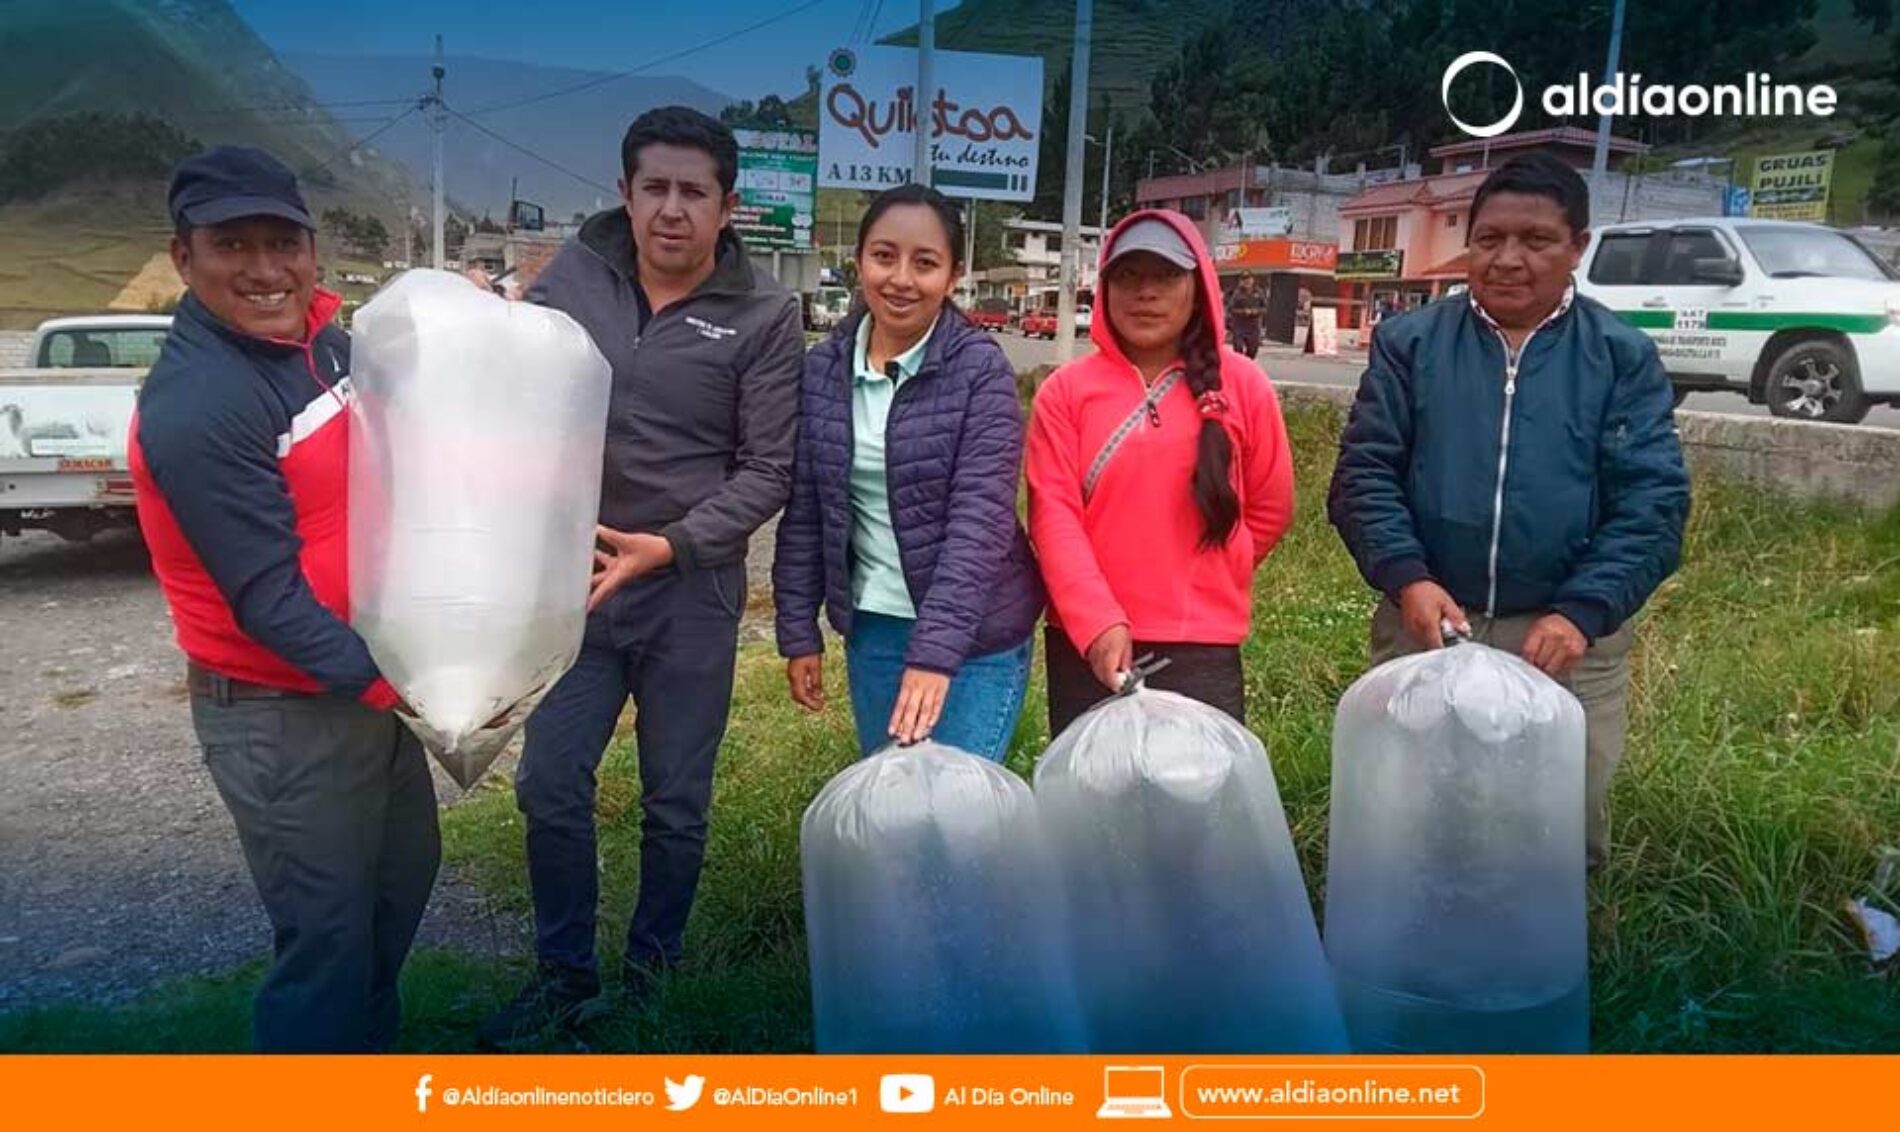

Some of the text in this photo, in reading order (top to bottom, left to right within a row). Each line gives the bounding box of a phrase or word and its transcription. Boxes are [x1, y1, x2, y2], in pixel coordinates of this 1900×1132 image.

[930, 142, 1030, 169] tu destino
[1760, 153, 1828, 172] GRUAS
[827, 163, 842, 181] A
[849, 165, 872, 183] 13
[877, 166, 912, 185] KM
